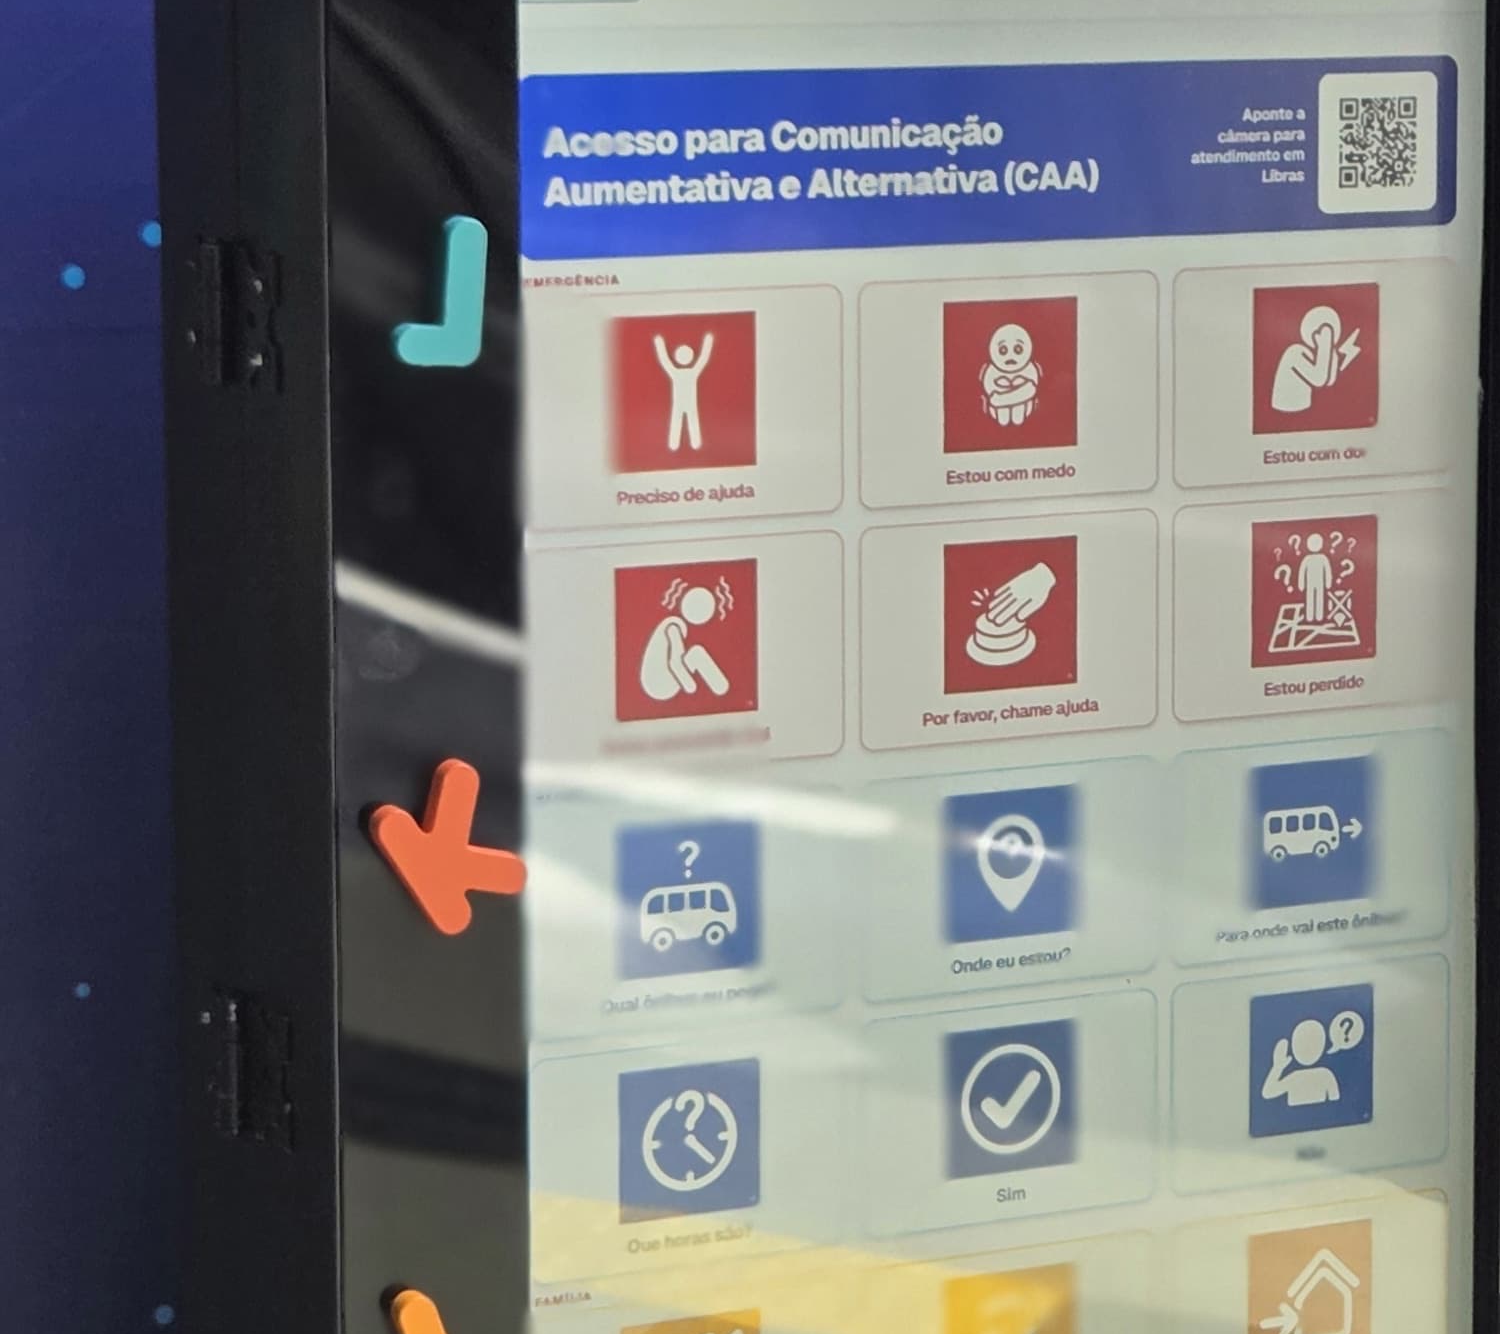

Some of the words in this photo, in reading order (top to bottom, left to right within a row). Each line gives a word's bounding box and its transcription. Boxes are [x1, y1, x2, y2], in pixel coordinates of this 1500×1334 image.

[1242, 107, 1294, 123] Aponte
[1296, 108, 1306, 121] a
[543, 126, 678, 158] Acesso
[684, 126, 766, 160] para
[771, 114, 1003, 155] Comunicação
[1217, 128, 1271, 144] câmera
[1273, 129, 1306, 144] para
[1190, 149, 1281, 165] atendimento
[1283, 149, 1305, 162] em
[544, 171, 774, 208] Aumentativa
[778, 176, 801, 199] e
[808, 164, 998, 199] Alternativa
[1004, 159, 1100, 196] (CAA)
[1261, 168, 1305, 184] Libras
[397, 216, 488, 366] J
[1263, 450, 1305, 464] Estou
[1309, 449, 1340, 461] com
[946, 470, 991, 485] Estou
[994, 469, 1028, 482] com
[1032, 463, 1076, 479] medo
[616, 488, 680, 505] Preciso
[683, 486, 705, 501] de
[708, 484, 755, 502] ajuda
[1264, 680, 1304, 697] Estou
[1308, 675, 1365, 696] perdido
[922, 712, 949, 727] Por
[954, 709, 997, 724] favor,
[1000, 703, 1053, 720] chame
[1056, 699, 1099, 717] ajuda
[1251, 923, 1289, 939] onde
[1317, 917, 1348, 933] este
[952, 956, 992, 974] Onde
[996, 956, 1015, 969] eu
[996, 1187, 1027, 1203] Sim
